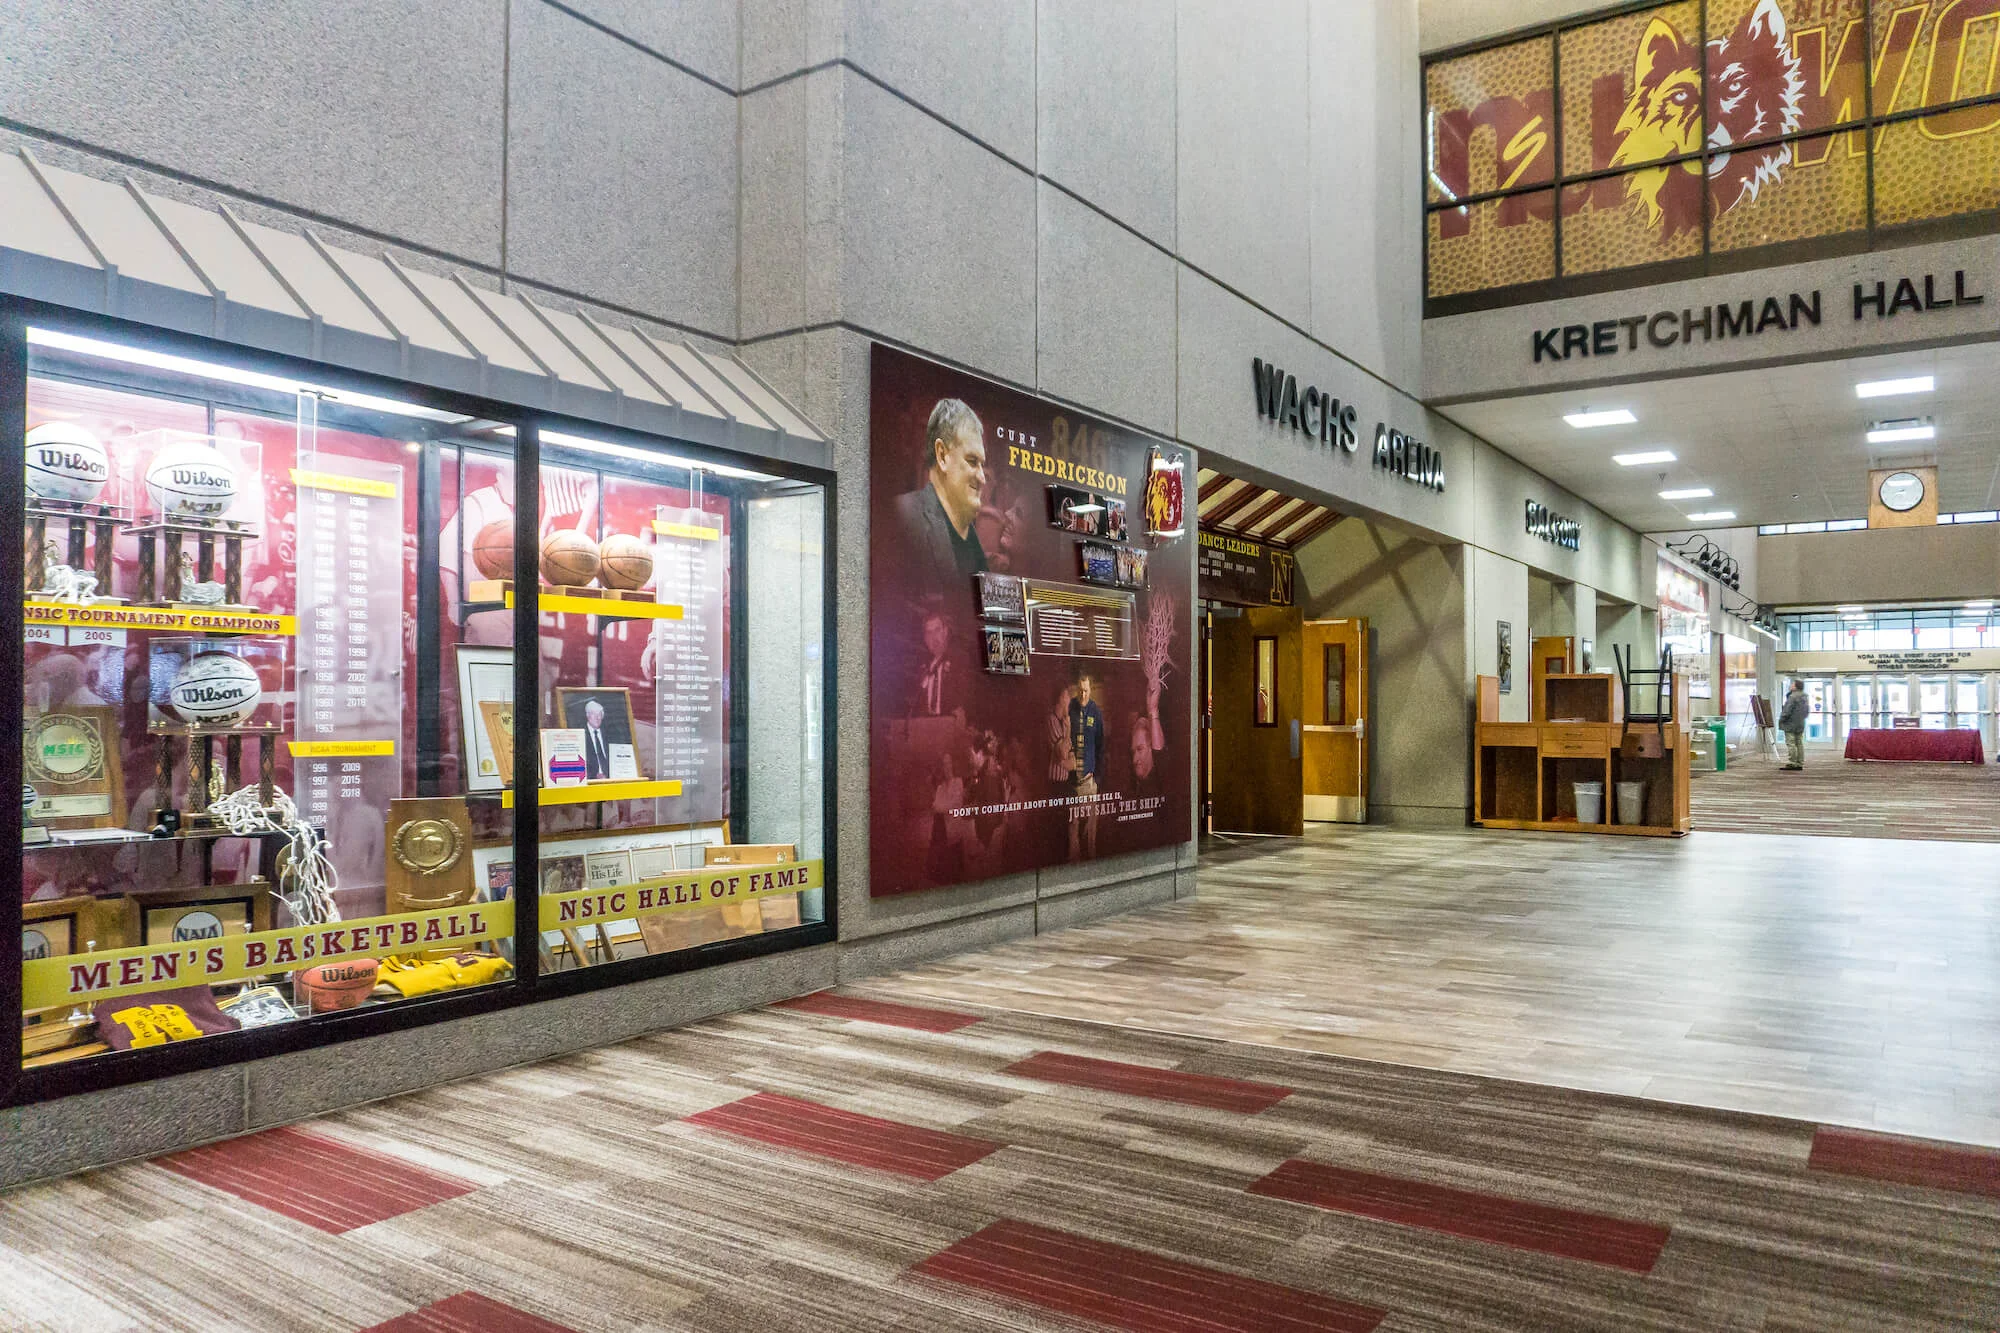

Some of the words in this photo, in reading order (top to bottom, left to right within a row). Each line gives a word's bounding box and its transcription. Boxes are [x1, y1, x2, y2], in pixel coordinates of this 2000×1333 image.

[1533, 289, 1822, 363] KRETCHMAN
[1853, 269, 1984, 322] HALL
[1253, 356, 1360, 453] WACHS
[1372, 422, 1446, 493] ARENA
[996, 426, 1037, 448] CURT
[39, 449, 106, 477] Wilson
[1008, 445, 1127, 495] FREDRICKSON
[172, 469, 231, 489] Wilson
[1226, 538, 1260, 558] LEADERS
[24, 606, 63, 620] NSIC
[68, 608, 186, 626] TOURNAMENT
[190, 615, 280, 631] CHAMPIONS
[84, 630, 112, 641] 2005
[347, 673, 367, 682] 2002
[181, 686, 244, 703] Wilson
[196, 711, 240, 723] NCAA
[315, 711, 333, 720] 1961
[331, 744, 376, 752] TOURNAMENT
[340, 762, 361, 772] 2009
[340, 775, 361, 785] 2015
[340, 788, 360, 798] 2018
[981, 804, 1022, 815] COMPLAIN
[1023, 799, 1047, 810] ABOUT
[1049, 798, 1064, 807] HOW
[1066, 795, 1089, 805] ROUGH
[1089, 793, 1101, 802] THE
[1102, 792, 1113, 801] SEA
[1069, 805, 1092, 822] JUST
[1094, 801, 1117, 816] SAIL
[1119, 798, 1138, 813] THE
[591, 870, 606, 880] His
[607, 869, 623, 878] Life
[559, 892, 626, 922] NSIC
[637, 882, 702, 910] HALL
[710, 877, 740, 898] OF
[749, 866, 809, 892] FAME
[176, 923, 220, 943] NAIA
[69, 945, 225, 994] MEN'S
[245, 912, 487, 969] BASKETBALL
[320, 966, 374, 983] Wilson
